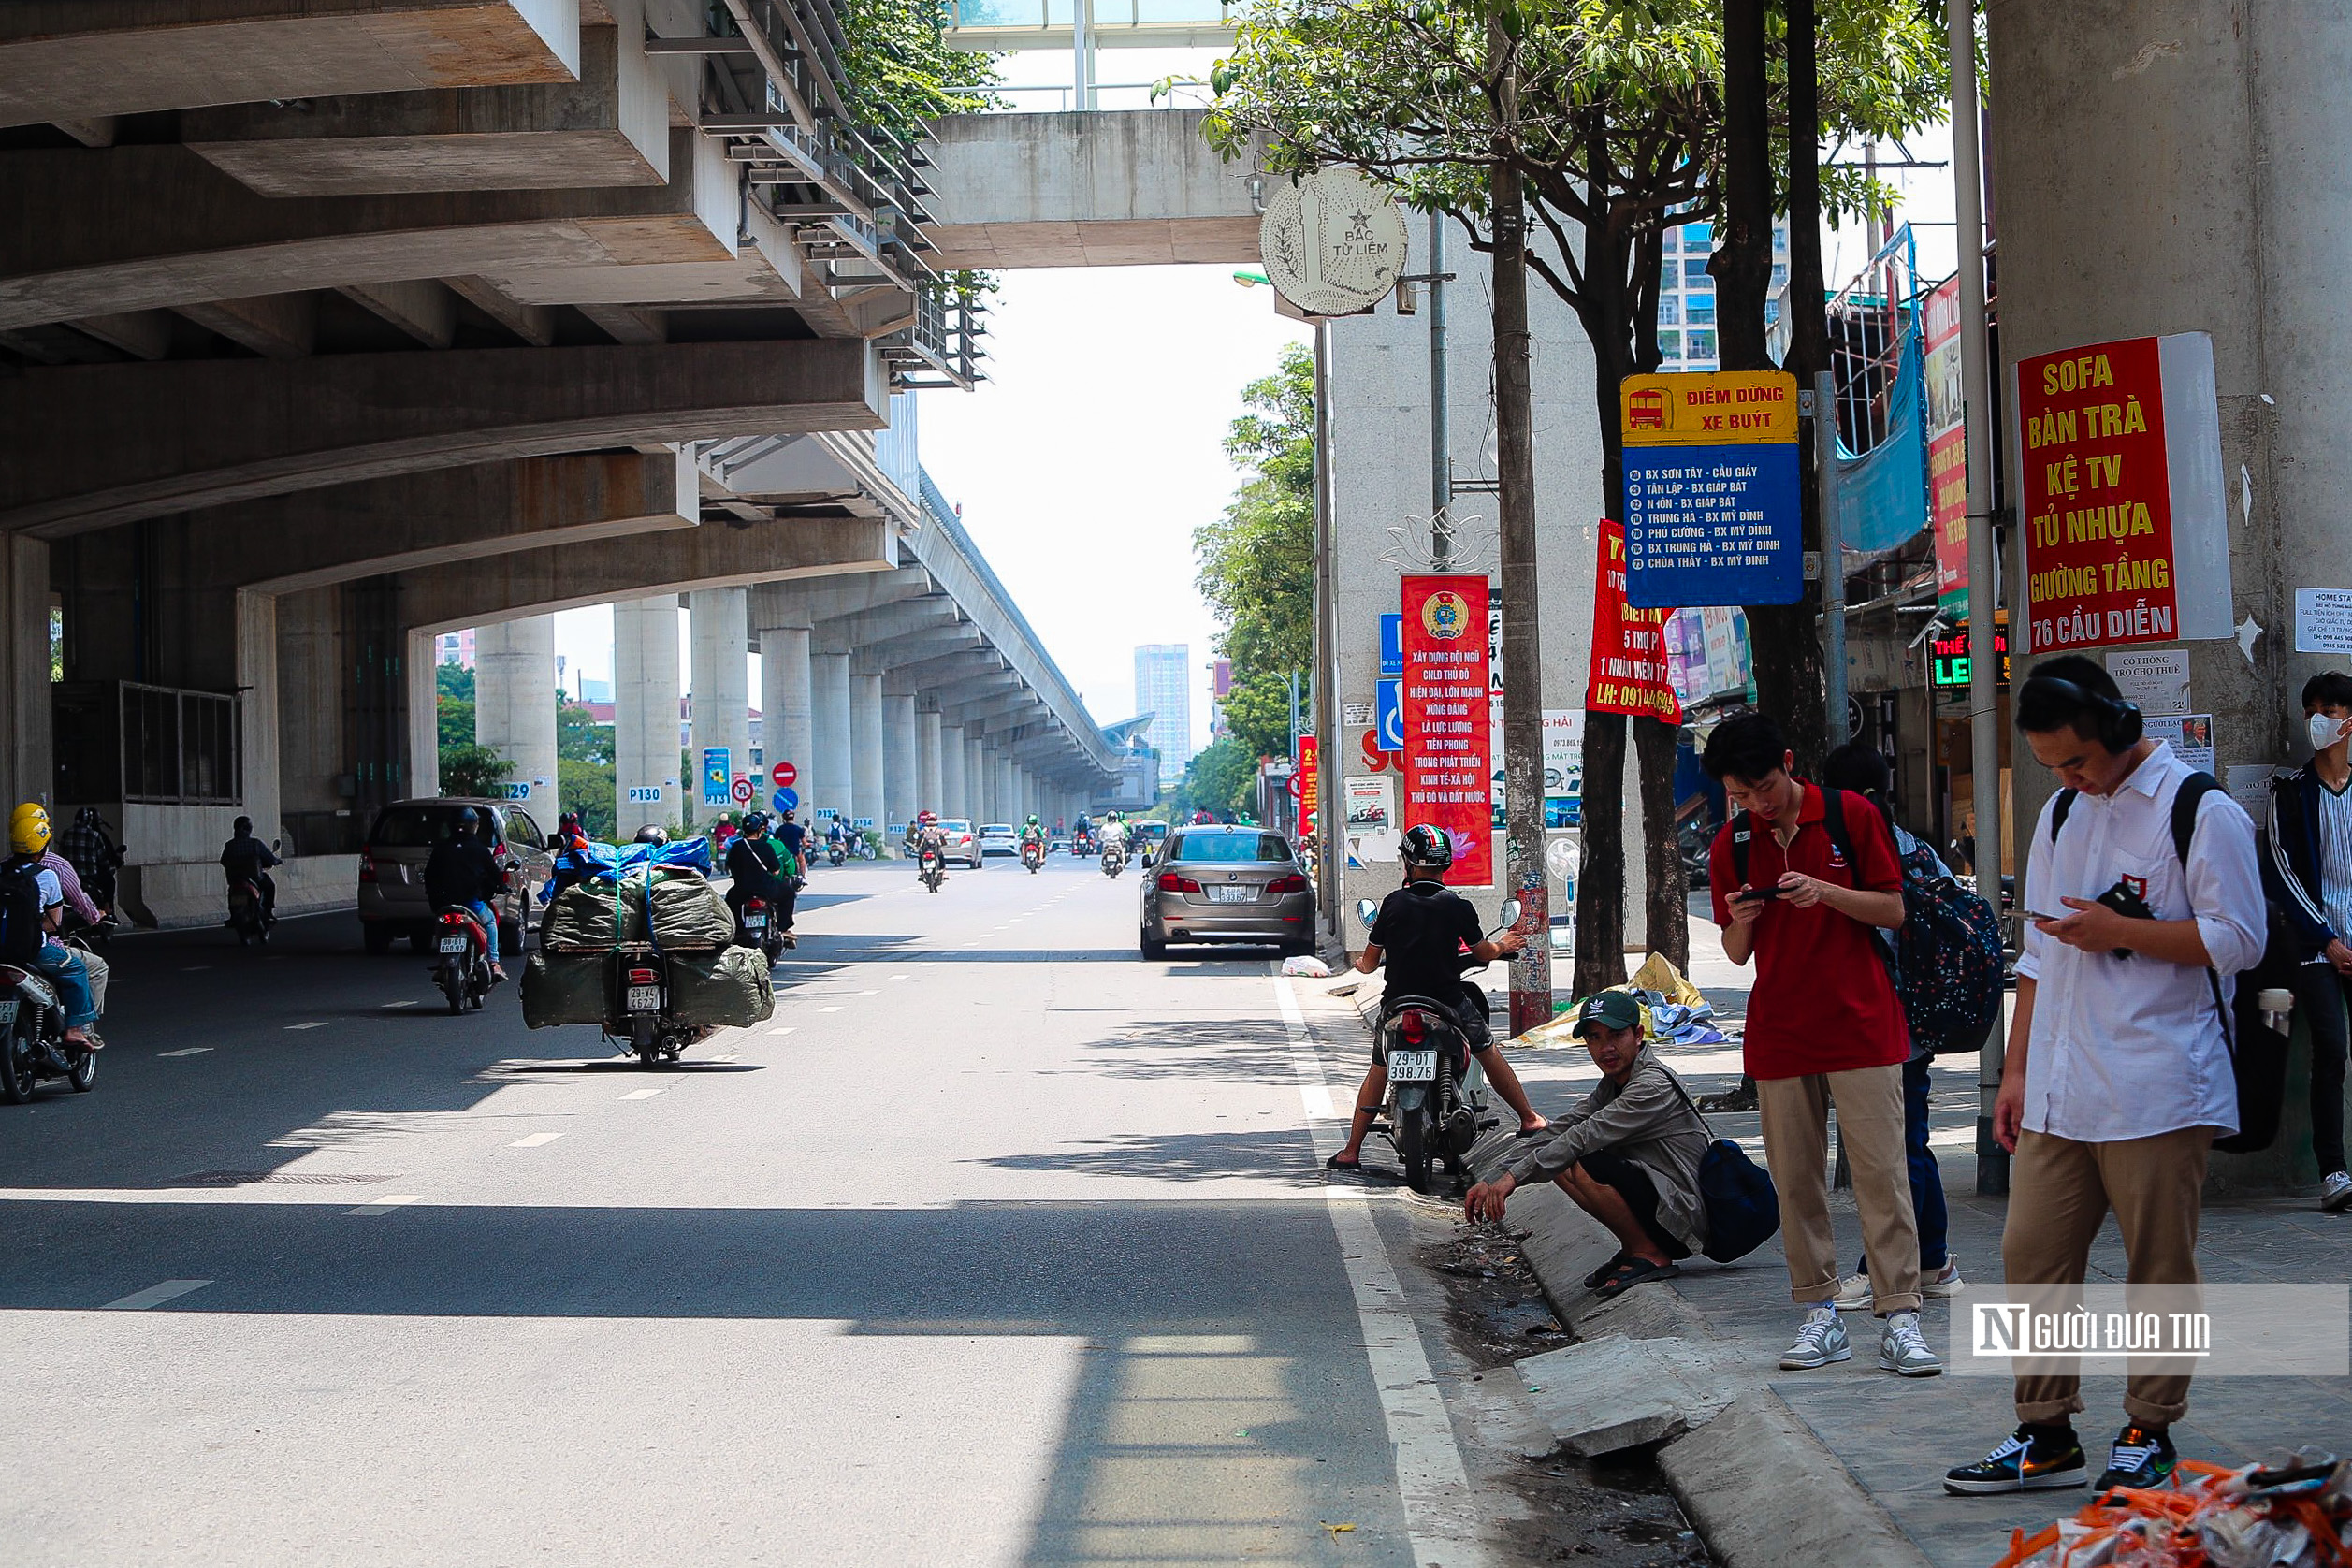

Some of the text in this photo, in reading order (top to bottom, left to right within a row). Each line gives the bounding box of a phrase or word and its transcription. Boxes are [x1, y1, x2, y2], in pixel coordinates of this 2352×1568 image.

[1345, 227, 1374, 241] BẮC
[1333, 241, 1388, 256] TỪ LIÊM
[2042, 354, 2114, 396] SOFA
[1686, 383, 1784, 407] ĐIỂM DỪNG
[1702, 410, 1772, 431] XE BUÝT
[2028, 394, 2147, 449] BÀN TRÀ
[1646, 470, 1658, 479] BX
[1662, 468, 1682, 479] SƠN
[1684, 467, 1703, 479] TÂY
[1712, 463, 1733, 478] CẦU
[2046, 454, 2122, 500] KỆ TV
[1647, 483, 1663, 495] TÂN
[1666, 482, 1683, 496] LẬP
[1691, 483, 1704, 494] BX
[1706, 480, 1727, 493] GIÁP
[1680, 498, 1693, 509] BX
[1695, 496, 1716, 508] GIÁP
[1647, 513, 1680, 524] TRUNG
[1682, 511, 1695, 522] HÀ
[1706, 513, 1719, 522] BX
[2033, 501, 2154, 548] TỦ NHỰA
[1648, 526, 1667, 539] PHÚ
[1671, 525, 1705, 538] CƯỜNG
[1714, 527, 1727, 537] BX
[1648, 544, 1662, 554] BX
[1664, 543, 1696, 553] TRUNG
[1699, 539, 1712, 552] HÀ
[1721, 542, 1735, 552] BX
[1648, 556, 1675, 568] CHÙA
[1710, 557, 1724, 567] BX
[2030, 552, 2170, 603] GIƯỜNG TẦNG
[2033, 598, 2171, 647] 76 CẦU DIỄN
[1624, 629, 1630, 649] 5
[1601, 657, 1605, 675] 1
[2123, 655, 2169, 665] CÓ PHÒNG
[1553, 716, 1572, 727] HẢI
[1361, 729, 1403, 773] S
[1444, 739, 1469, 750] PHONG
[1415, 756, 1439, 767] TRONG
[1420, 775, 1439, 786] KINH
[630, 788, 660, 801] P130
[1396, 1053, 1428, 1065] 29-D1
[1390, 1067, 1432, 1080] 398.76
